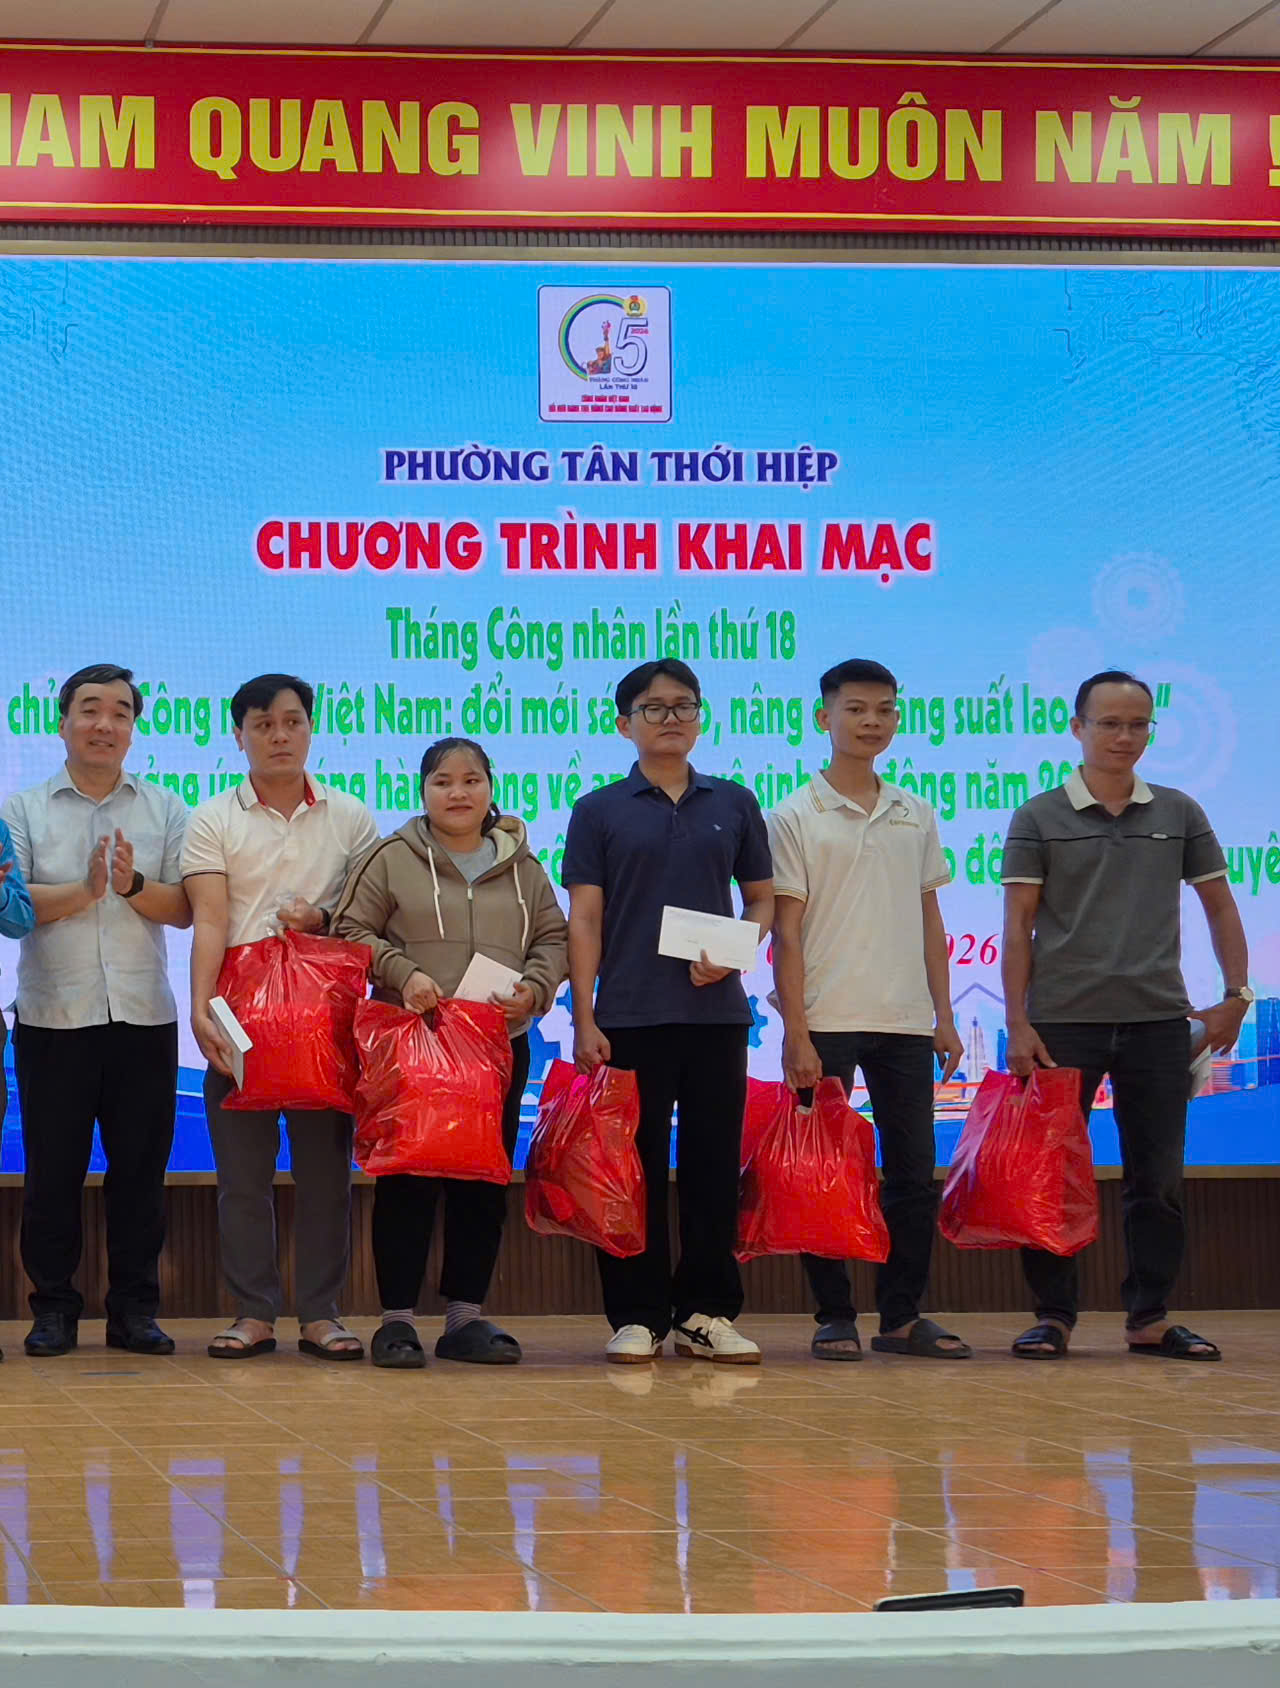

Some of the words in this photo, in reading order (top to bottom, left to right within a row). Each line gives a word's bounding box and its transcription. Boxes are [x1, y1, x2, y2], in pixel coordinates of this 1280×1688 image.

[189, 96, 480, 179] QUANG
[510, 103, 712, 178] VINH
[745, 91, 1002, 181] MUÔN
[1035, 95, 1232, 186] NĂM
[385, 444, 549, 482] PHƯỜNG
[561, 445, 638, 482] TÂN
[650, 445, 744, 482] THỚI
[756, 446, 838, 490] HIỆP
[257, 521, 482, 571] CHƯƠNG
[500, 511, 657, 571] TRÌNH
[678, 524, 802, 571] KHAI
[822, 523, 933, 583] MẠC
[386, 606, 478, 670] Tháng
[487, 606, 564, 670] Công
[573, 607, 647, 660] nhân
[656, 599, 700, 660] lần
[709, 607, 759, 660] thứ
[766, 611, 796, 660] 18
[8, 678, 61, 736] chủ
[375, 682, 452, 735] Nam:
[461, 671, 513, 735] đổi
[521, 682, 578, 735] mới
[587, 682, 617, 736] sá
[730, 682, 804, 746] nâng
[894, 684, 945, 746] ăng
[954, 674, 1014, 735] suất
[1022, 682, 1069, 735] lao
[547, 750, 583, 811] về
[966, 758, 1030, 810] năm
